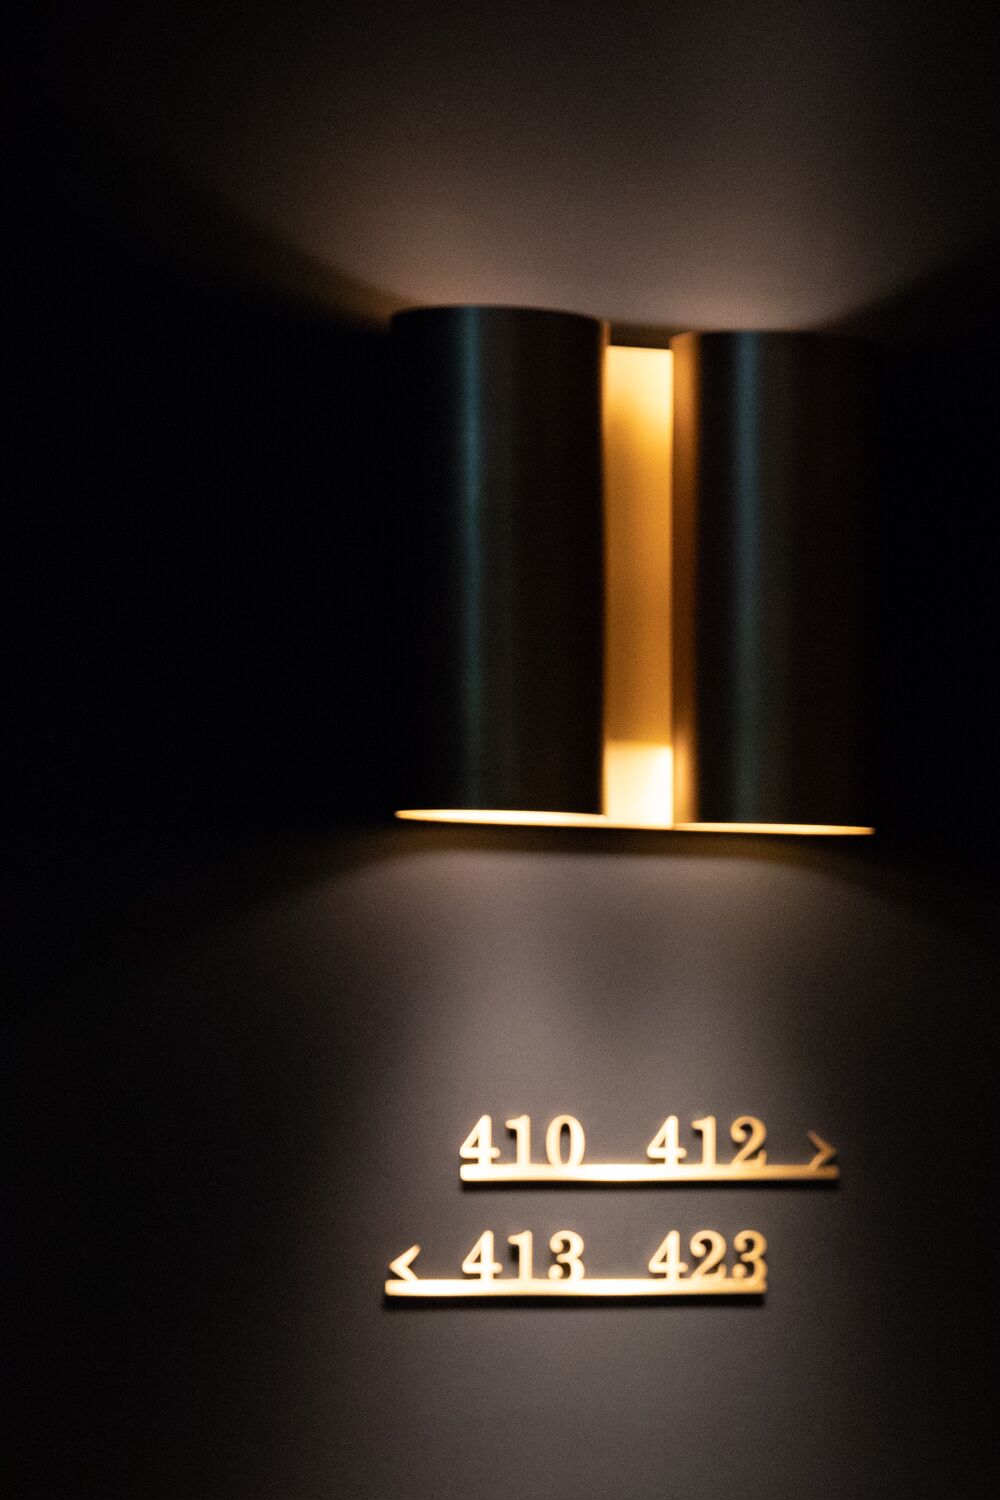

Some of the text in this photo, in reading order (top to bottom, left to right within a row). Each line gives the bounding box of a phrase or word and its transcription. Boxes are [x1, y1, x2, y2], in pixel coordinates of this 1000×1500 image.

[459, 1114, 767, 1165] 410 412
[462, 1229, 768, 1281] 413 423
